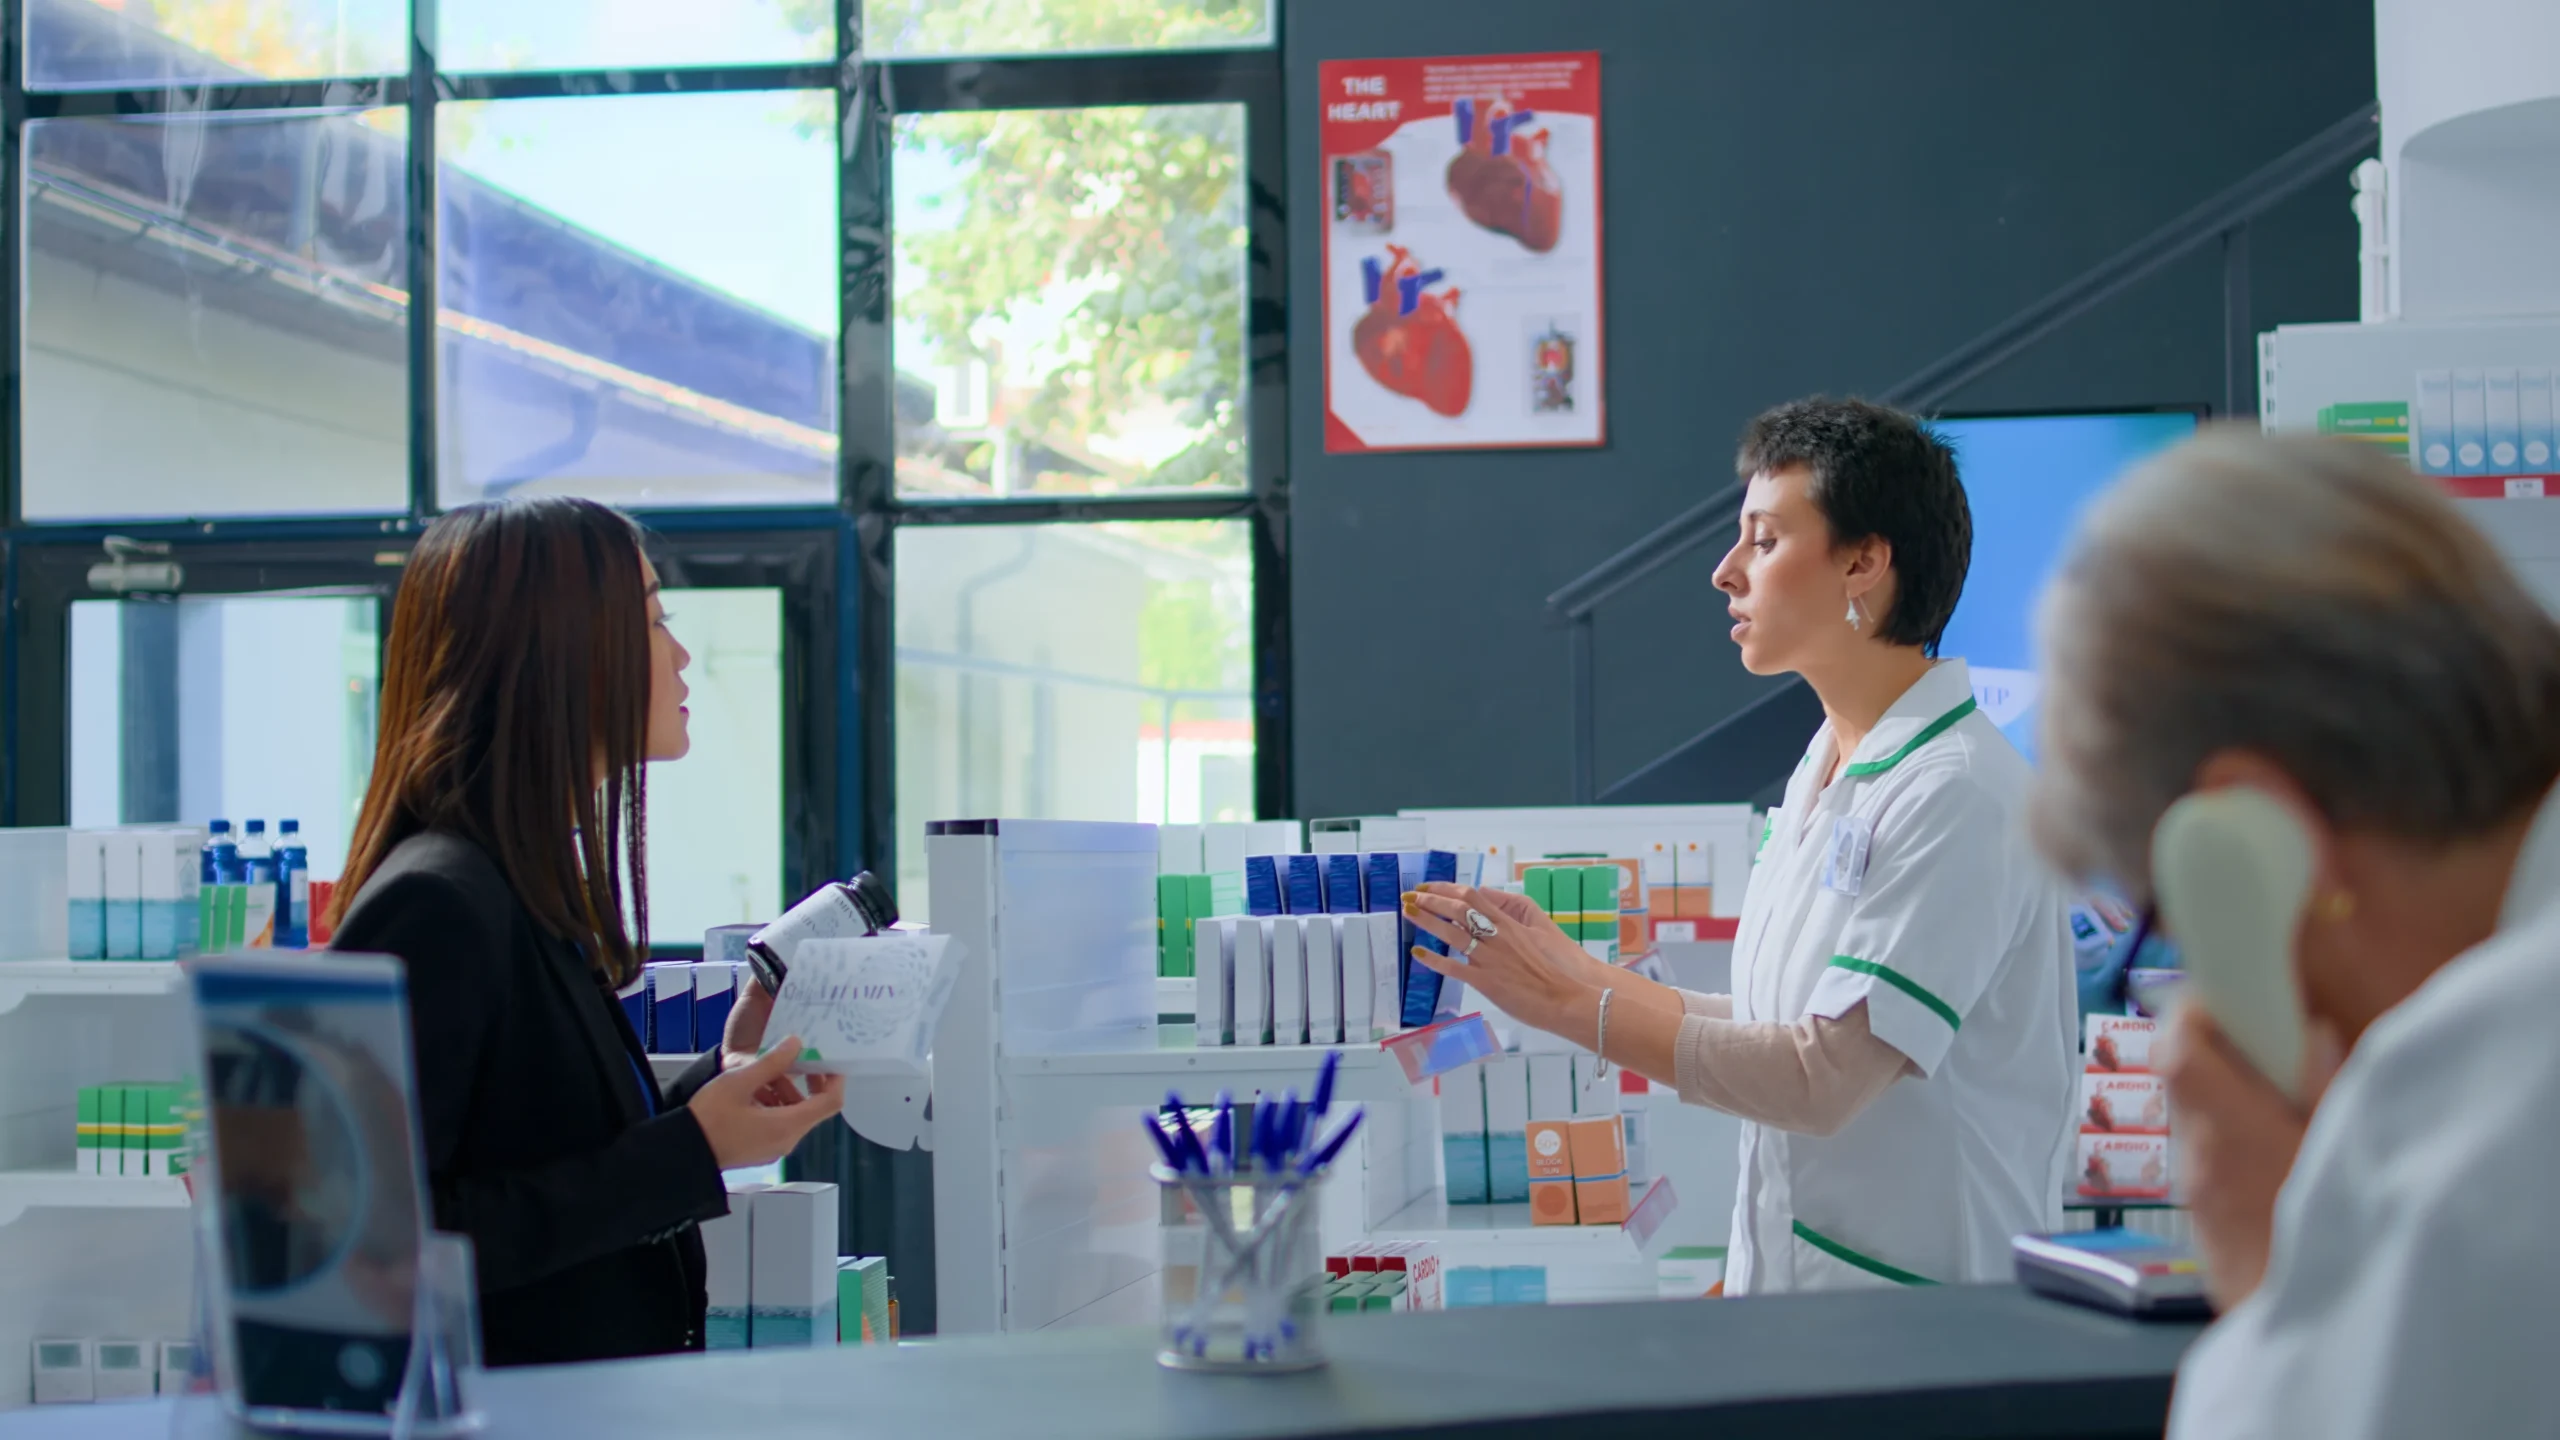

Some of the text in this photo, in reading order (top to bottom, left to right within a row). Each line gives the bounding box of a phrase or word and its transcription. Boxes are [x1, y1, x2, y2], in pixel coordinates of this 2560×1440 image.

[1341, 76, 1386, 95] THE
[1327, 101, 1402, 121] HEART
[2101, 1020, 2156, 1034] CARDIO
[2096, 1081, 2152, 1094] CARDIO
[2094, 1141, 2150, 1154] CARDIO
[1536, 1158, 1563, 1167] BLOCK
[1542, 1167, 1560, 1175] SUN
[1412, 1255, 1436, 1284] CARDIO
